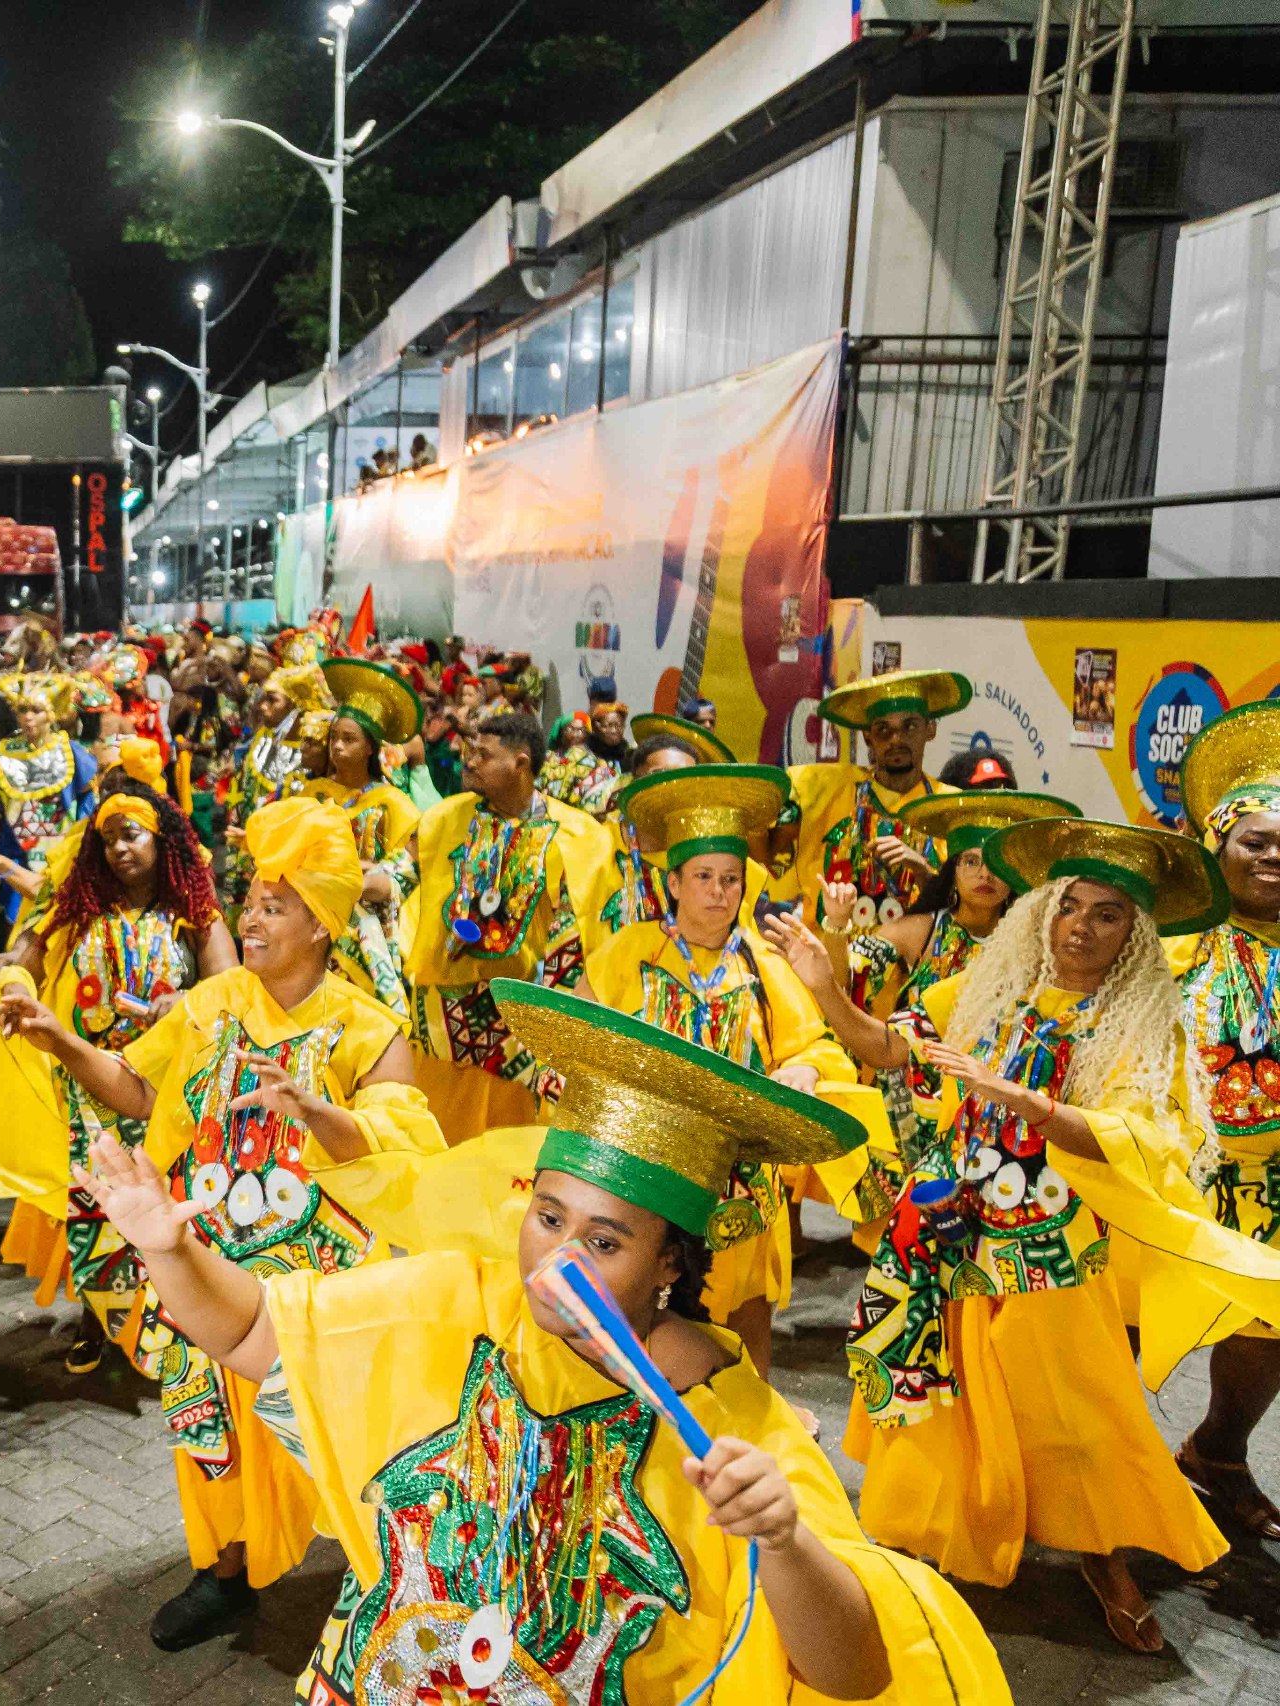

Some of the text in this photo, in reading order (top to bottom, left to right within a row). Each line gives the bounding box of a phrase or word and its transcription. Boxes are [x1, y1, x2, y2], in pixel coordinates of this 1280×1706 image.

[985, 682, 1045, 759] SALVADOR
[1156, 704, 1203, 734] CLUB
[1148, 733, 1189, 764] SOC
[172, 1402, 214, 1429] 2026
